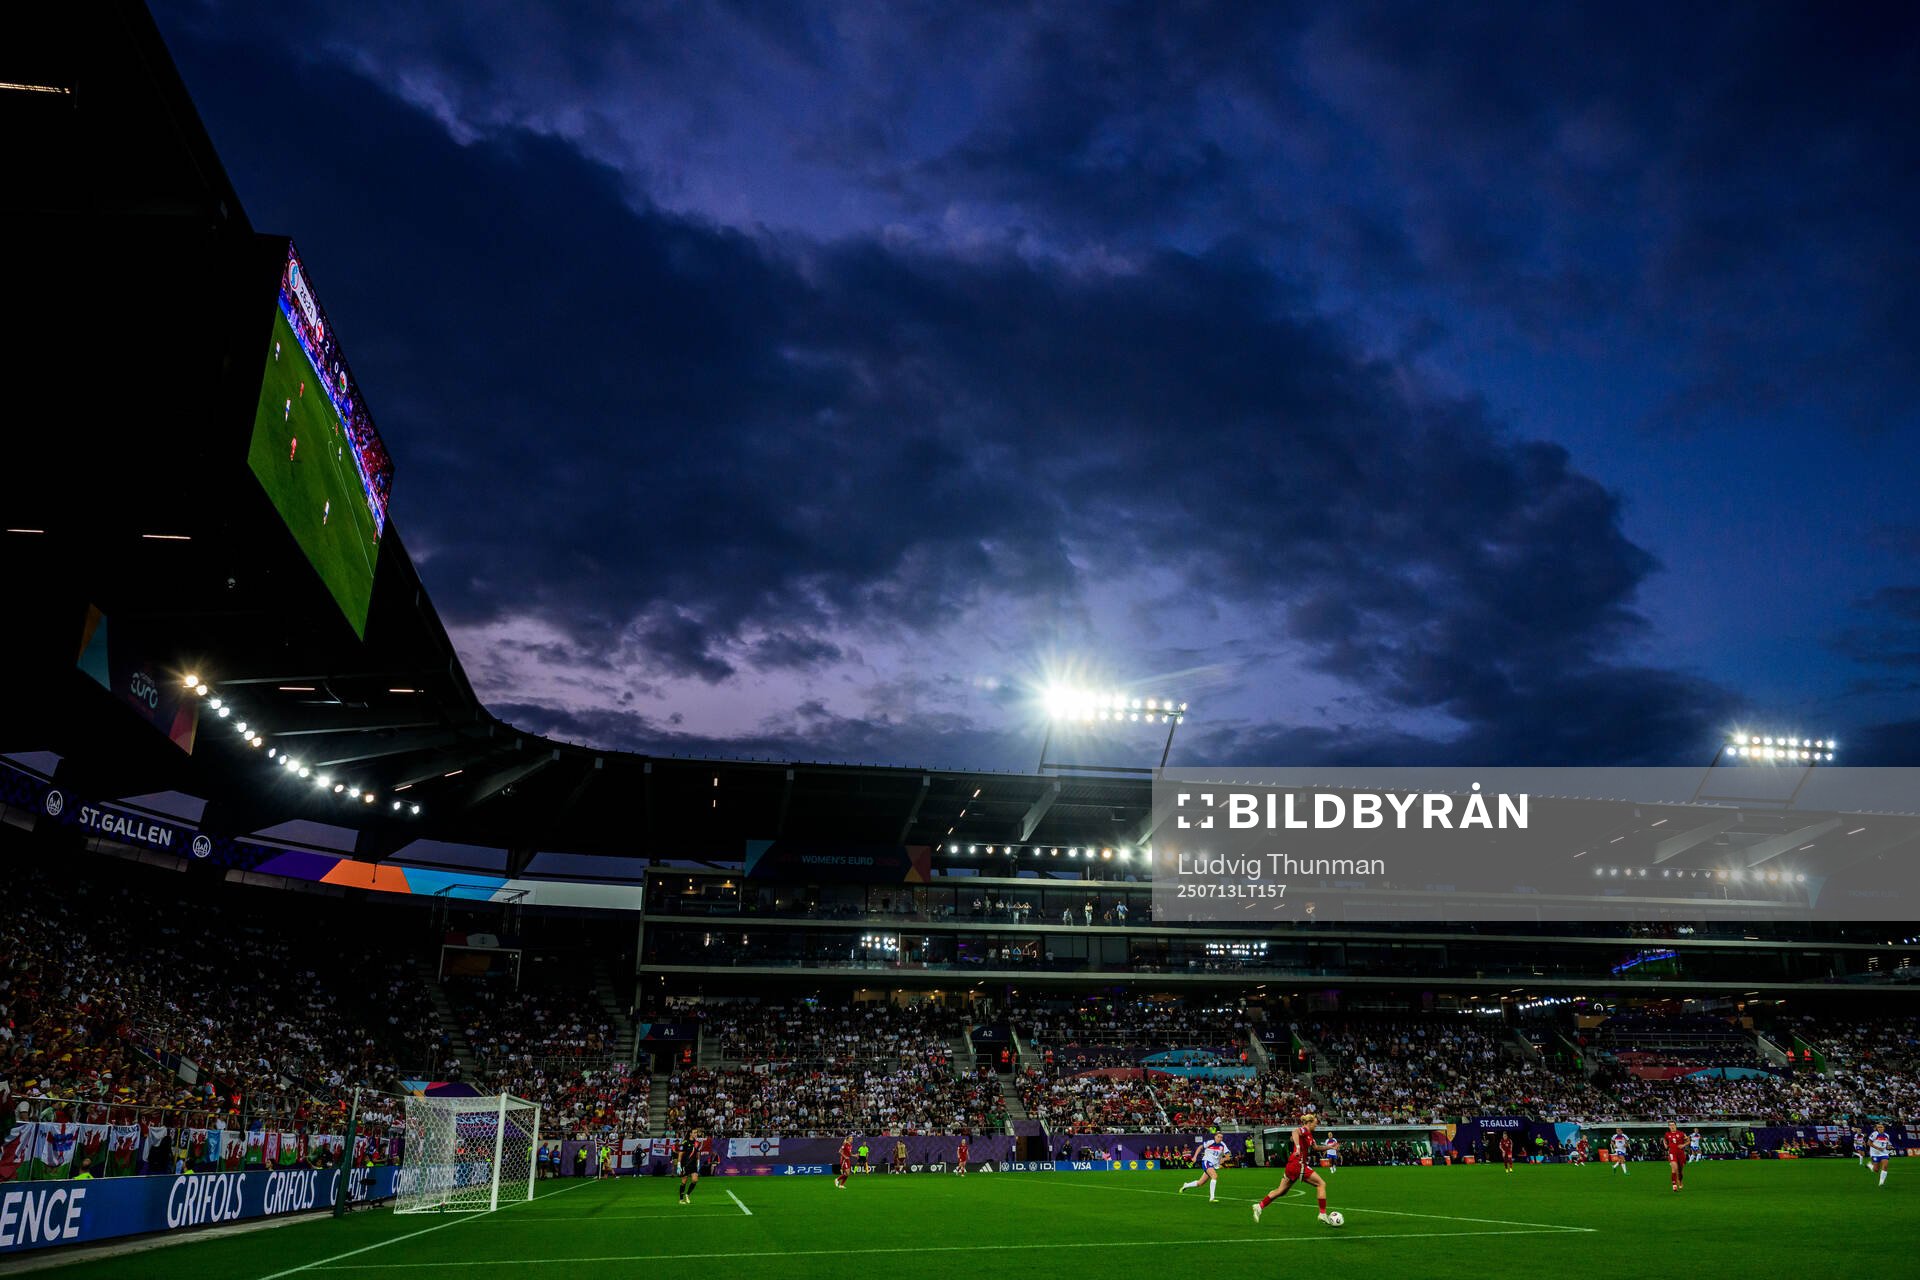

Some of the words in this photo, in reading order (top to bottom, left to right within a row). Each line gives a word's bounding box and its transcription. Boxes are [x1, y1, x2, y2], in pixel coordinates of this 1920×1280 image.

[79, 806, 173, 846] ST.GALLEN
[1479, 1119, 1519, 1128] ST.GALLEN
[797, 1166, 822, 1174] PS5
[1072, 1161, 1092, 1170] VISA
[167, 1173, 246, 1229] GRIFOLS
[263, 1170, 318, 1215] GRIFOLS
